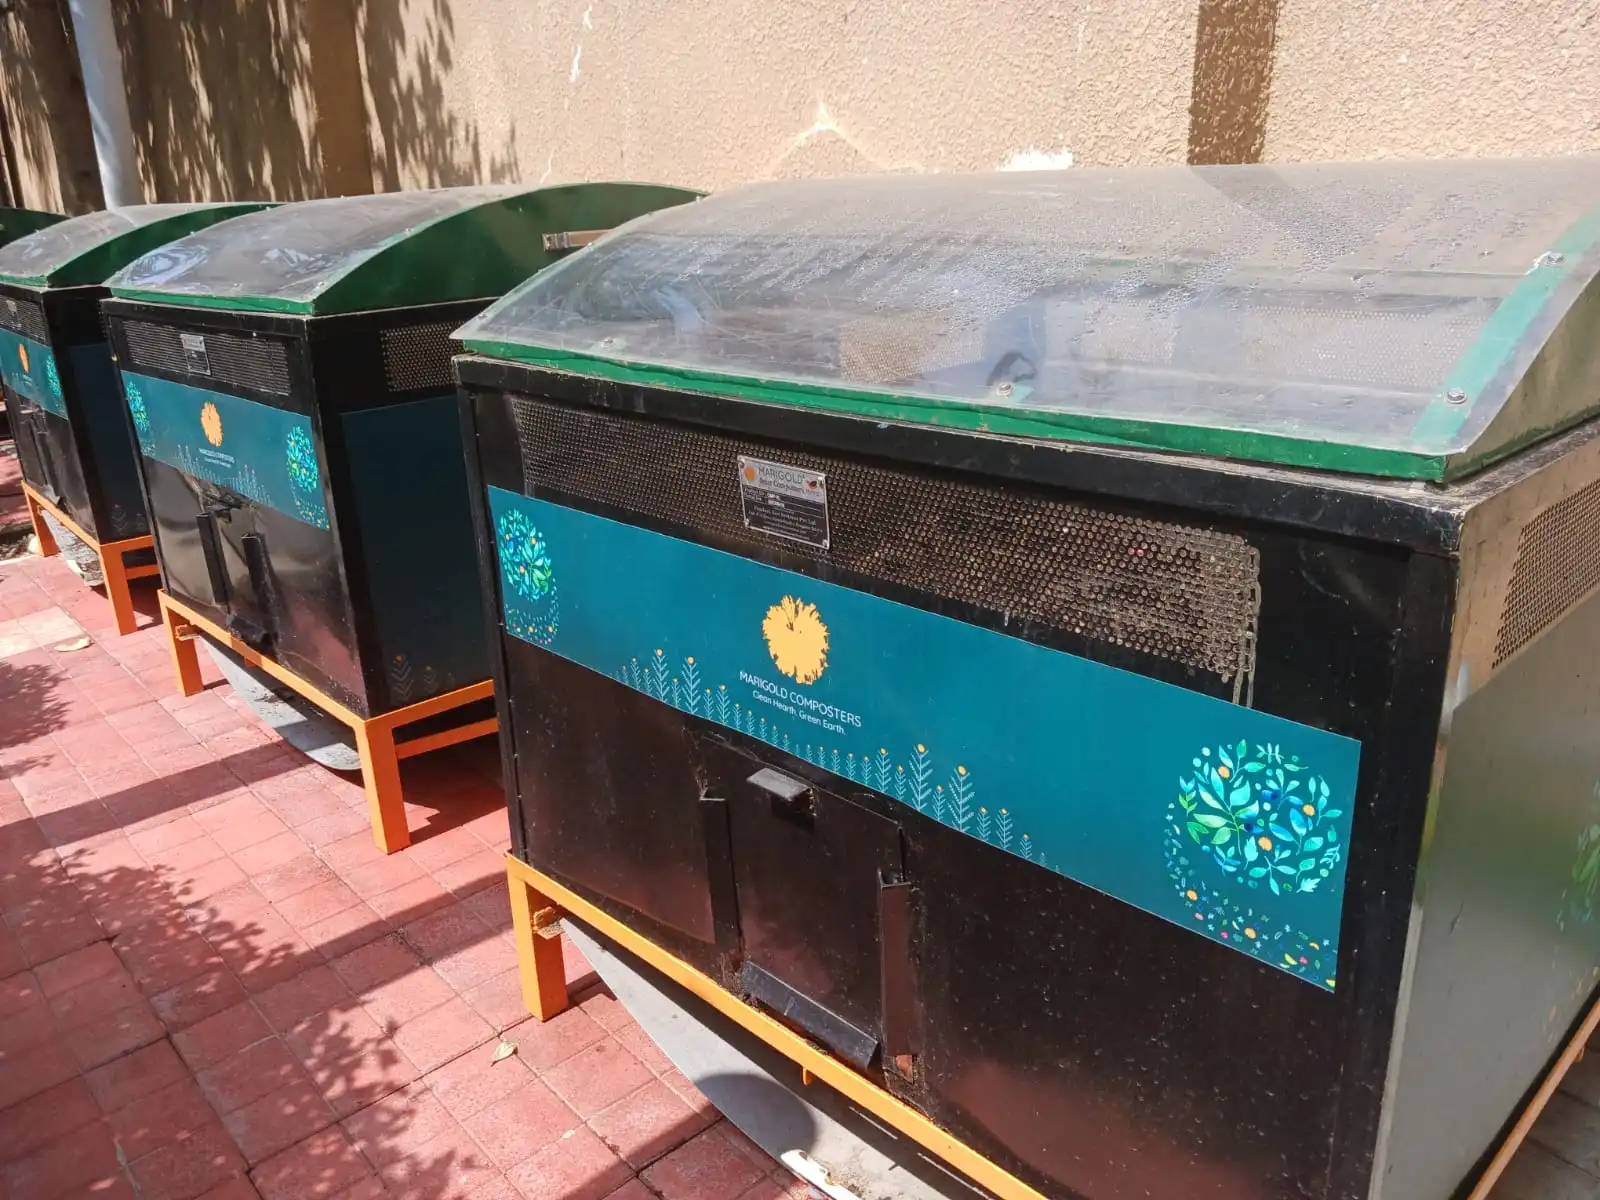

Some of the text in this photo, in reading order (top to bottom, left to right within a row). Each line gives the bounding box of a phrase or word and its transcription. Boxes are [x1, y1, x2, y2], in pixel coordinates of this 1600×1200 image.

[739, 670, 862, 728] MARIGOLD COMPOSTERS
[752, 689, 772, 705] Clean
[798, 709, 822, 726] Green
